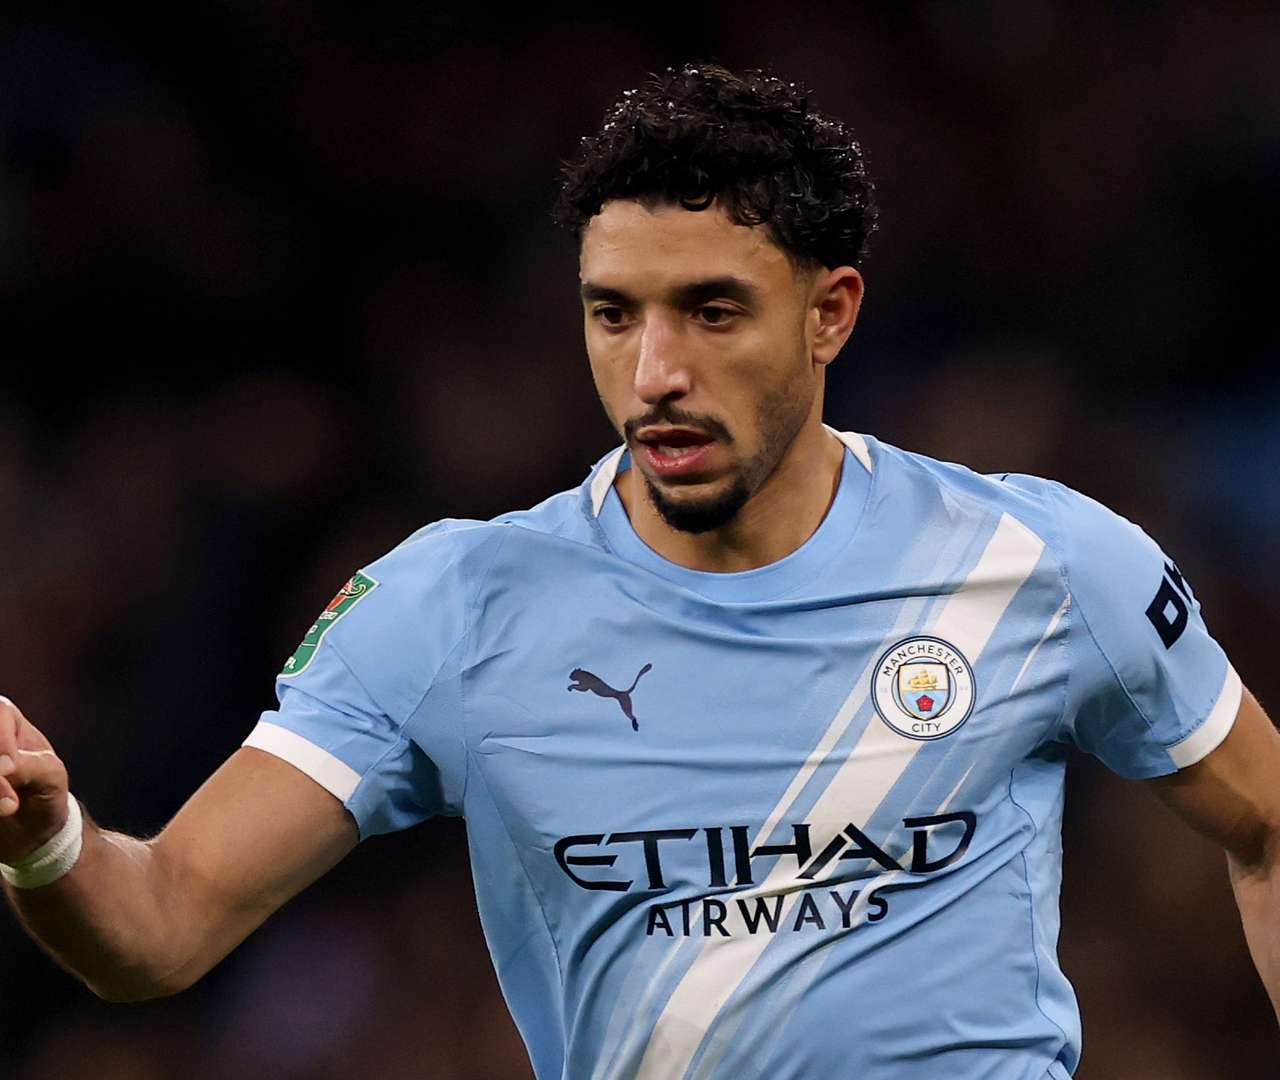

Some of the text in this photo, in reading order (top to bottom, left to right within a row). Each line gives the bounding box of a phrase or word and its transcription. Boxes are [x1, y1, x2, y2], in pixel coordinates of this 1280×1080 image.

[883, 644, 963, 677] MANCHESTER
[912, 723, 941, 732] CITY
[553, 811, 977, 891] ETIHAD
[646, 890, 888, 937] AIRWAYS
